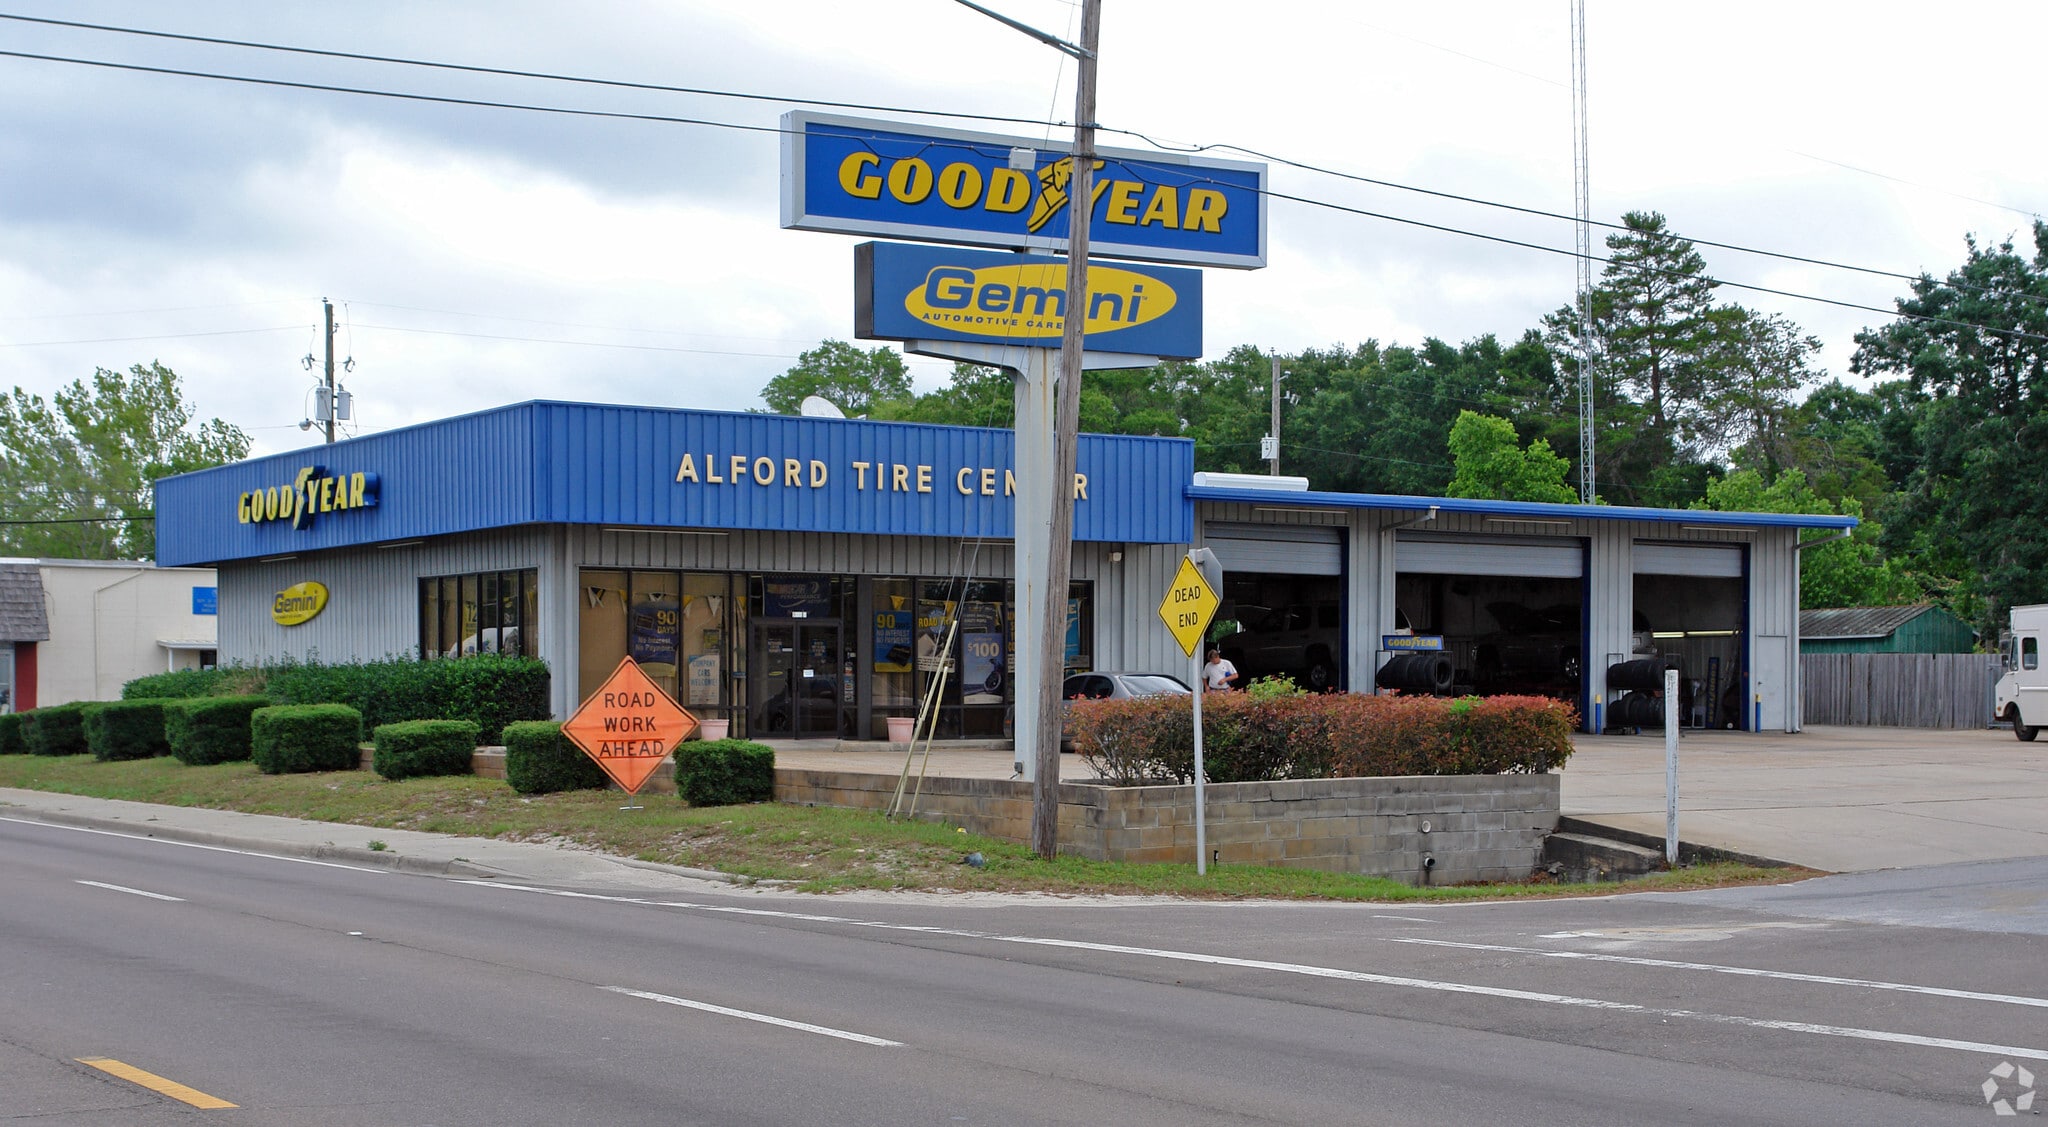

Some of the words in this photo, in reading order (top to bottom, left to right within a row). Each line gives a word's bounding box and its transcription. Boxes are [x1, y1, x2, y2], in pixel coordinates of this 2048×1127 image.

[925, 267, 1144, 323] Gemni
[922, 312, 1018, 327] AUTOMOTIVE
[1026, 320, 1064, 330] CARE
[676, 453, 828, 488] ALFORD
[852, 461, 932, 493] TIRE
[957, 467, 1088, 500] CENR
[238, 471, 365, 524] GOODYEAR
[275, 589, 318, 613] Gemini
[1175, 586, 1201, 603] DEAD
[657, 610, 676, 625] 90
[877, 614, 896, 629] 90
[919, 617, 938, 628] ROAD
[1179, 612, 1198, 628] END
[657, 625, 676, 635] DAYS
[968, 642, 1000, 657] $100
[1388, 637, 1438, 649] GOODYEAR
[604, 692, 655, 708] ROAD
[604, 716, 656, 732] WORK
[600, 740, 664, 757] AHEAD
